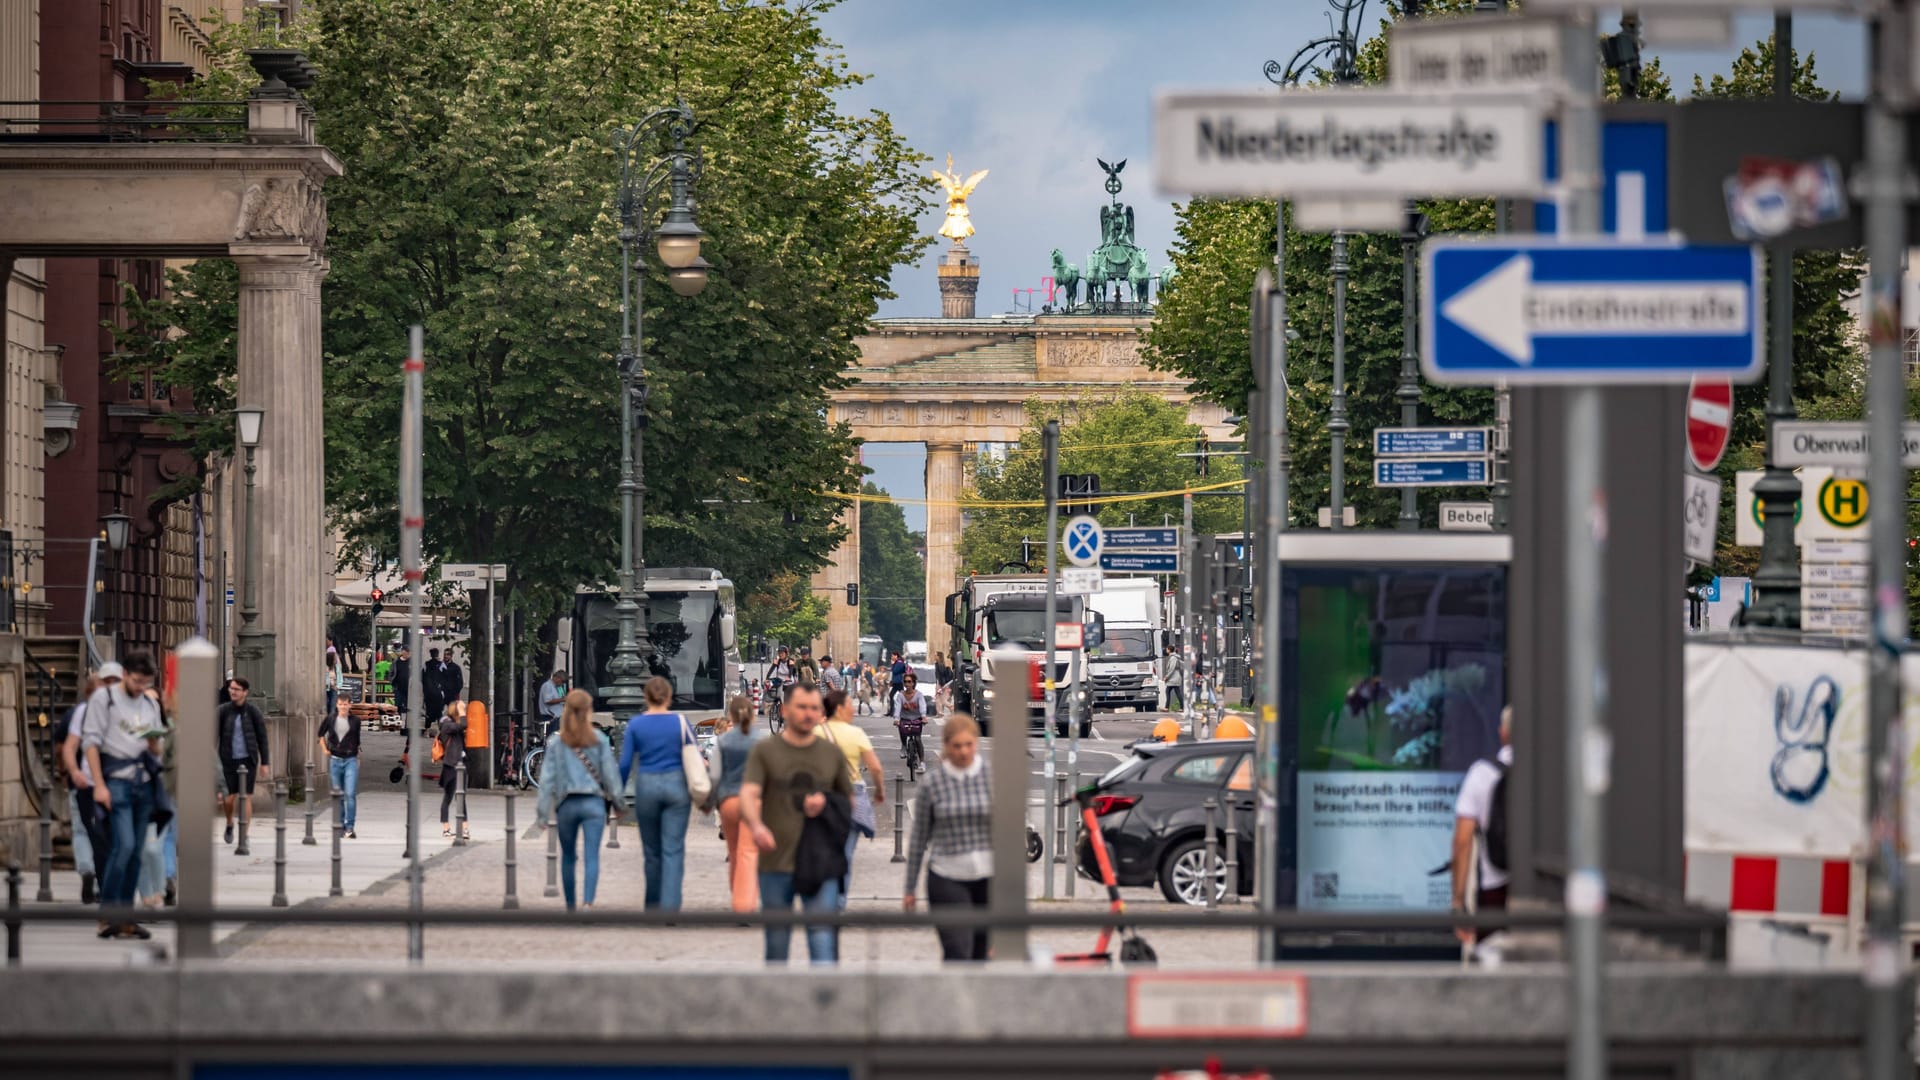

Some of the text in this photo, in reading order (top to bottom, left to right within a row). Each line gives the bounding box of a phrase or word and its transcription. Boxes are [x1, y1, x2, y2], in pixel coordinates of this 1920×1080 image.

[1196, 114, 1497, 172] Niederlagstraße
[1834, 486, 1859, 515] H
[1313, 801, 1380, 813] brauchen
[1385, 801, 1413, 813] Ihre
